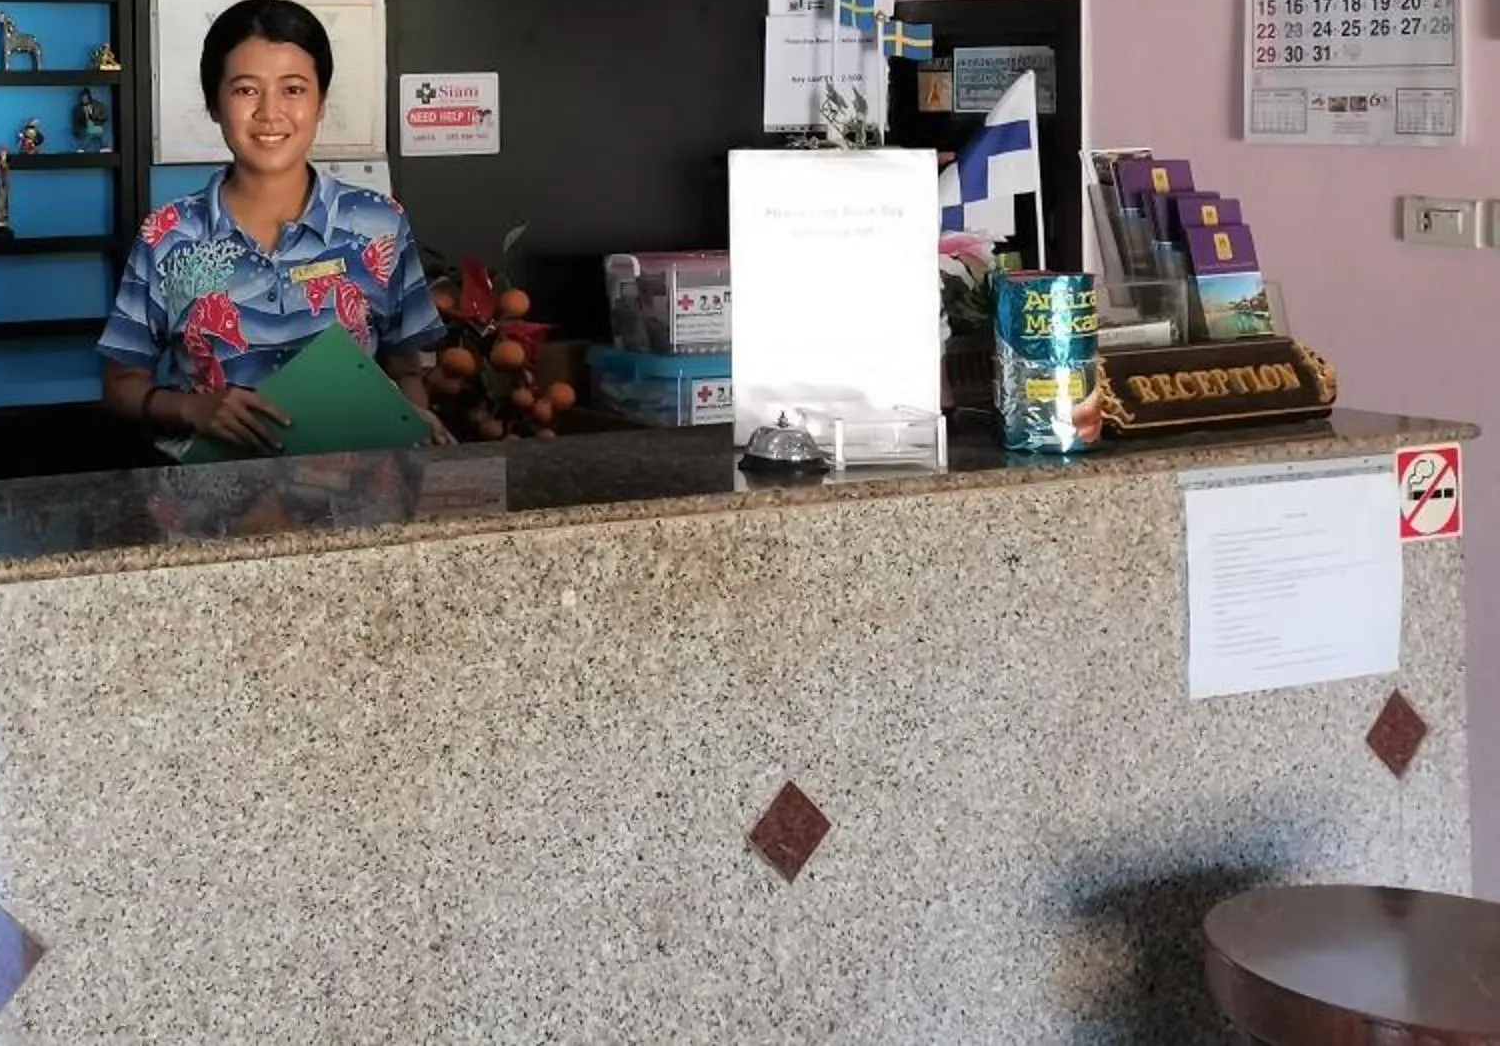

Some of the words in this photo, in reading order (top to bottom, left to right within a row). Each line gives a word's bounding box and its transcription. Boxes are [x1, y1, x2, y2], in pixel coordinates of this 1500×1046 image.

[1258, 0, 1276, 16] 15
[1285, 0, 1303, 14] 16
[1257, 24, 1276, 39] 22
[1313, 21, 1332, 37] 24
[1341, 20, 1361, 36] 25
[1370, 19, 1390, 35] 26
[1401, 18, 1422, 35] 27
[1256, 47, 1276, 63] 29
[1285, 46, 1303, 62] 30
[1313, 45, 1331, 61] 31
[438, 84, 479, 98] Siam
[409, 111, 437, 123] NEED
[1127, 362, 1300, 403] RECEPTION
